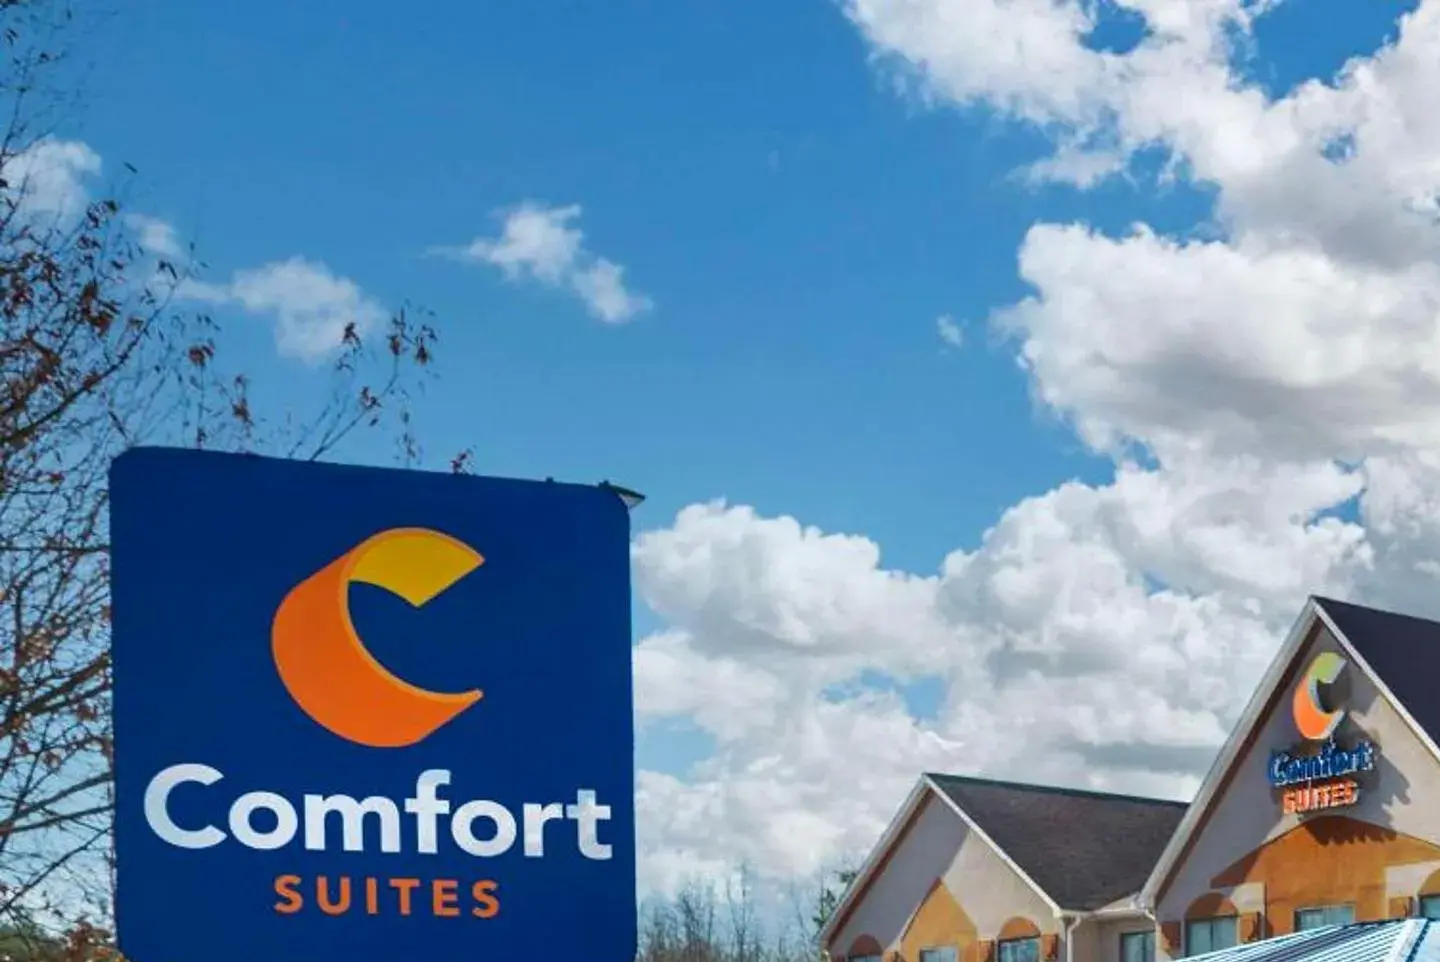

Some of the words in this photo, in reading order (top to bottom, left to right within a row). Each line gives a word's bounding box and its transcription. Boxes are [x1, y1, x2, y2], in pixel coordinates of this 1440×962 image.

[143, 763, 613, 860] Comfort
[1283, 779, 1359, 814] SUITES
[273, 875, 499, 918] SUITES
